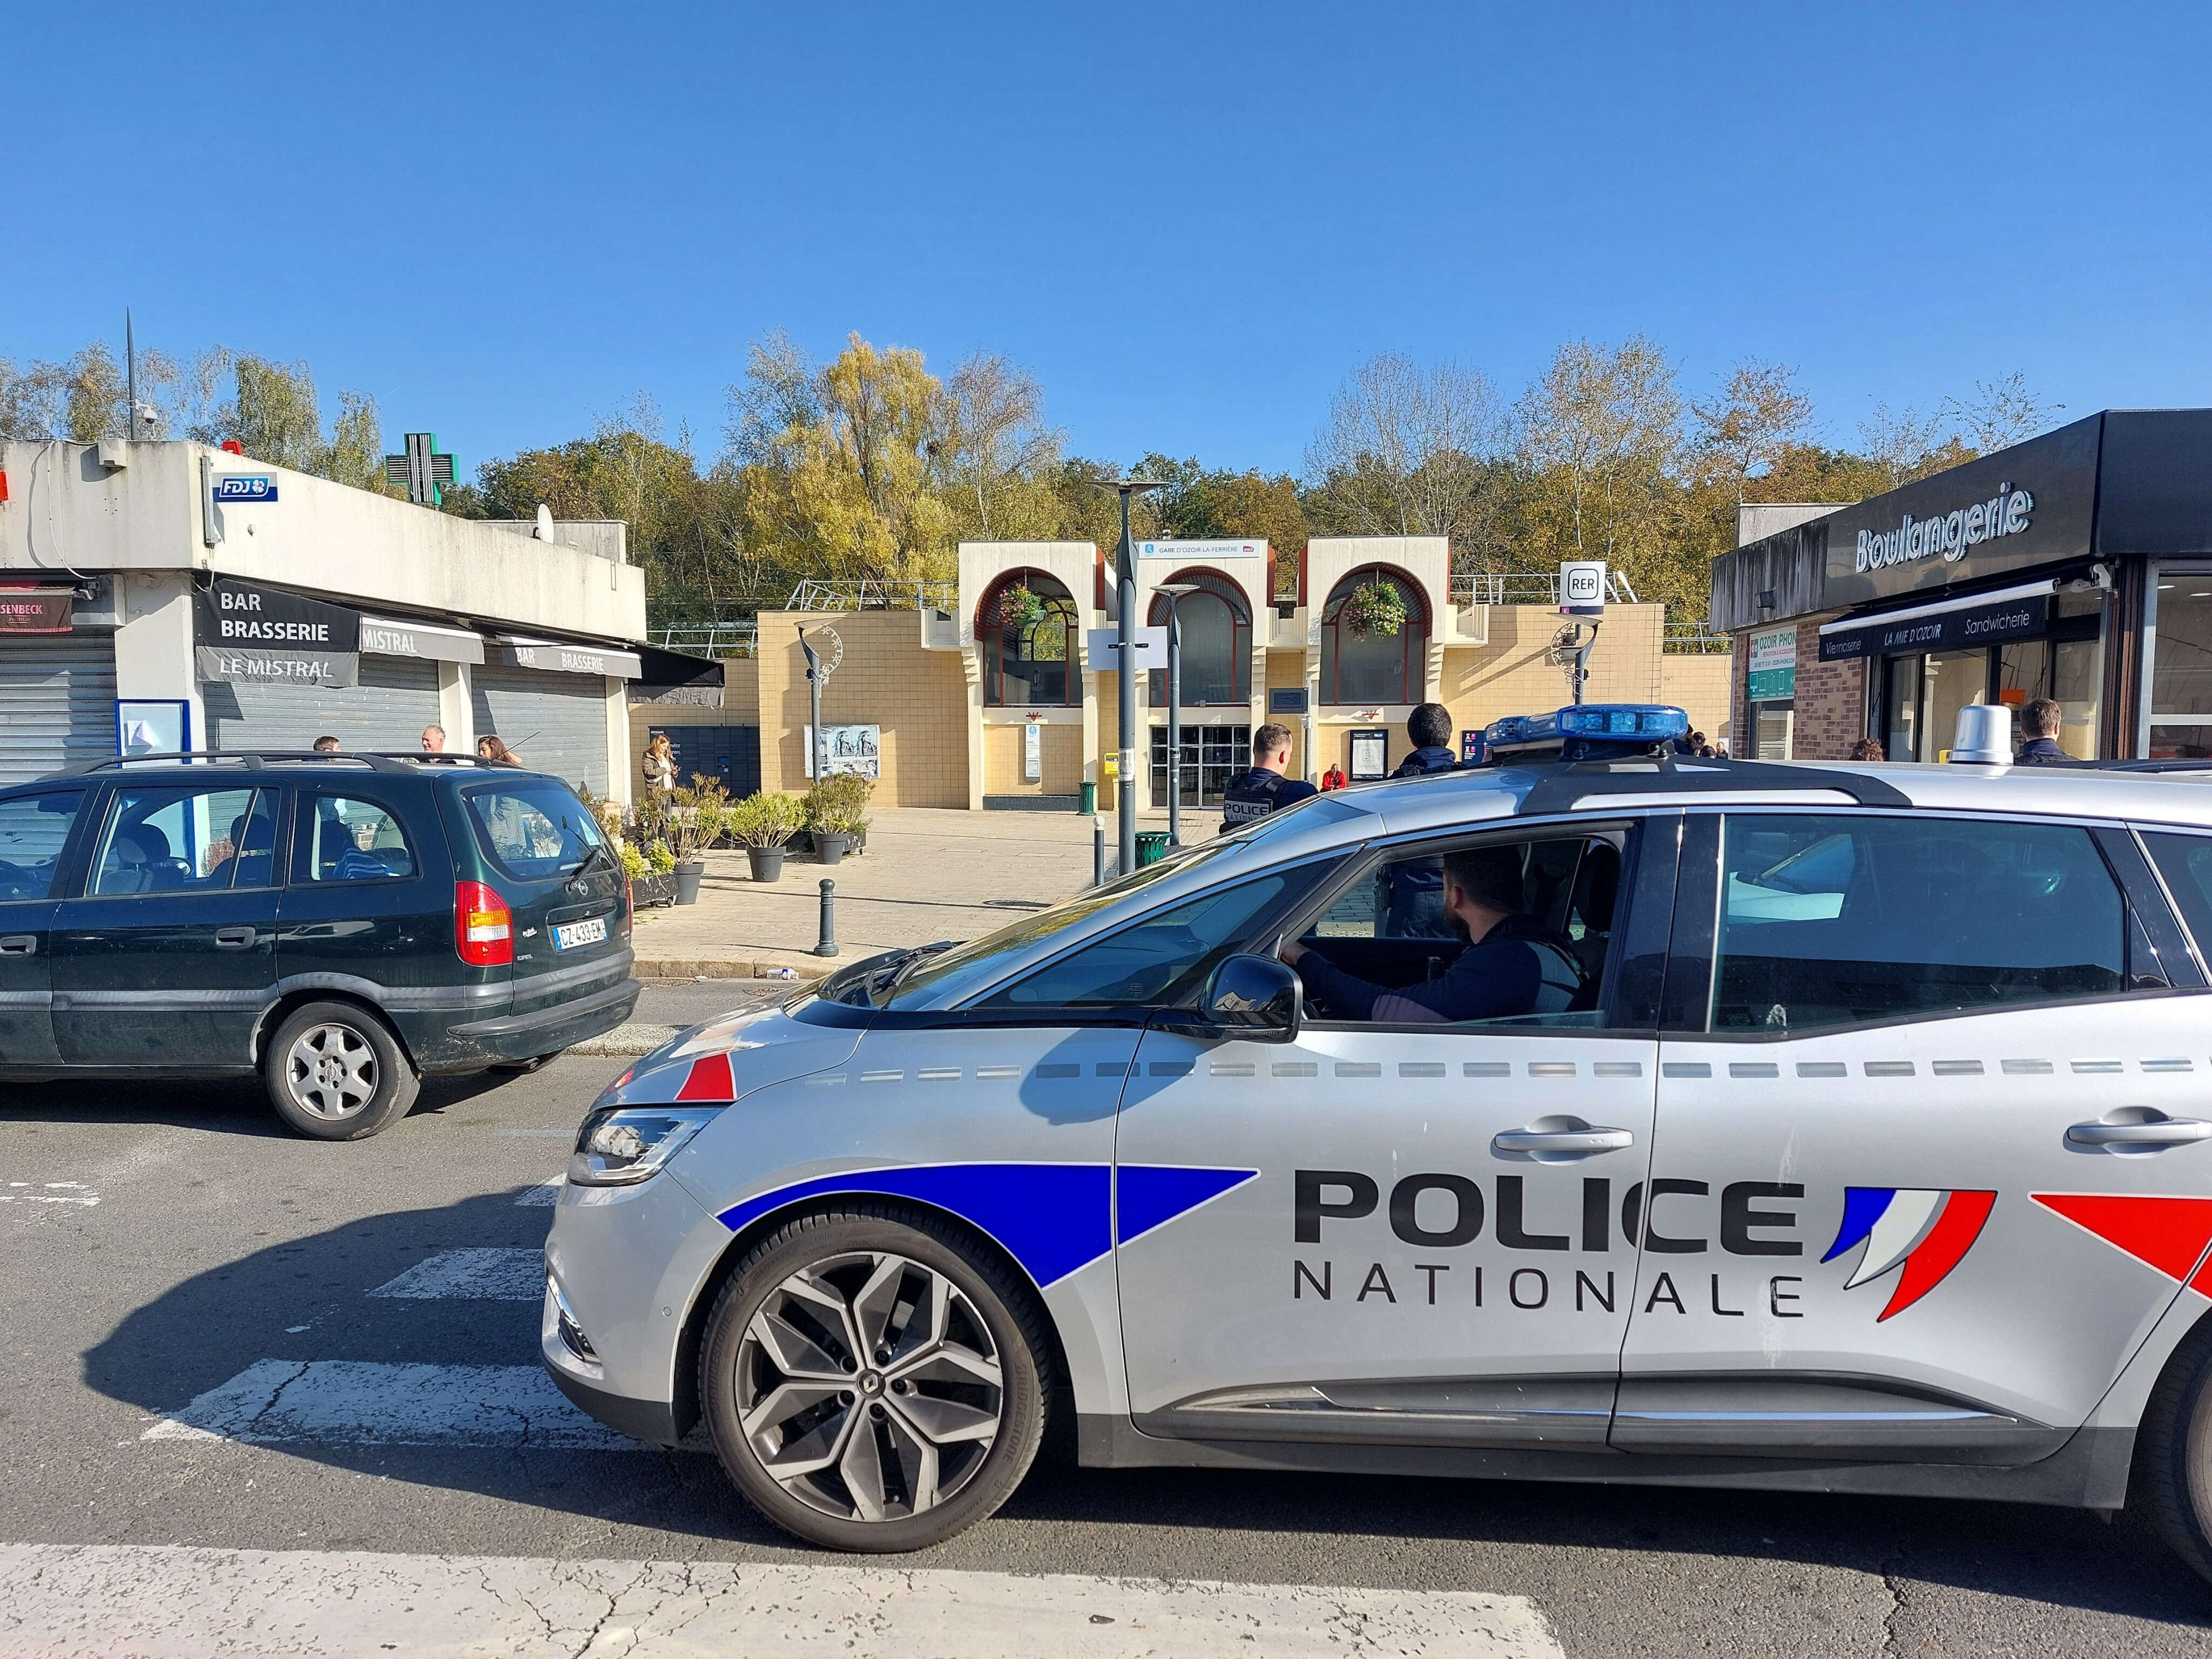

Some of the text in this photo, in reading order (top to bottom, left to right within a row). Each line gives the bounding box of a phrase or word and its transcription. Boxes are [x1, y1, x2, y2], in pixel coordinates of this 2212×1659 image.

[224, 481, 250, 493] FDJ
[1856, 482, 2034, 574] Boulangerie
[1572, 578, 1595, 590] RER
[0, 604, 43, 614] SENBECK
[221, 592, 262, 611] BAR
[221, 620, 329, 641] BRASSERIE
[1965, 609, 2030, 635] Sandwicherie
[362, 628, 418, 653] MISTRAL
[1759, 635, 1777, 650] OZOIR
[1884, 623, 1942, 646] LA MIE D'OZOIR
[1826, 637, 1862, 655] Viennoiserie
[220, 657, 334, 678] LE MISTRAL
[515, 648, 604, 671] BAR BRASSERIE
[1225, 804, 1268, 816] POLICE
[561, 921, 602, 946] CZ-433-EM
[1294, 1170, 1805, 1256] POLICE
[1294, 1260, 1804, 1318] NATIONALE
[1003, 1363, 1027, 1464] BRIDGESTONE
